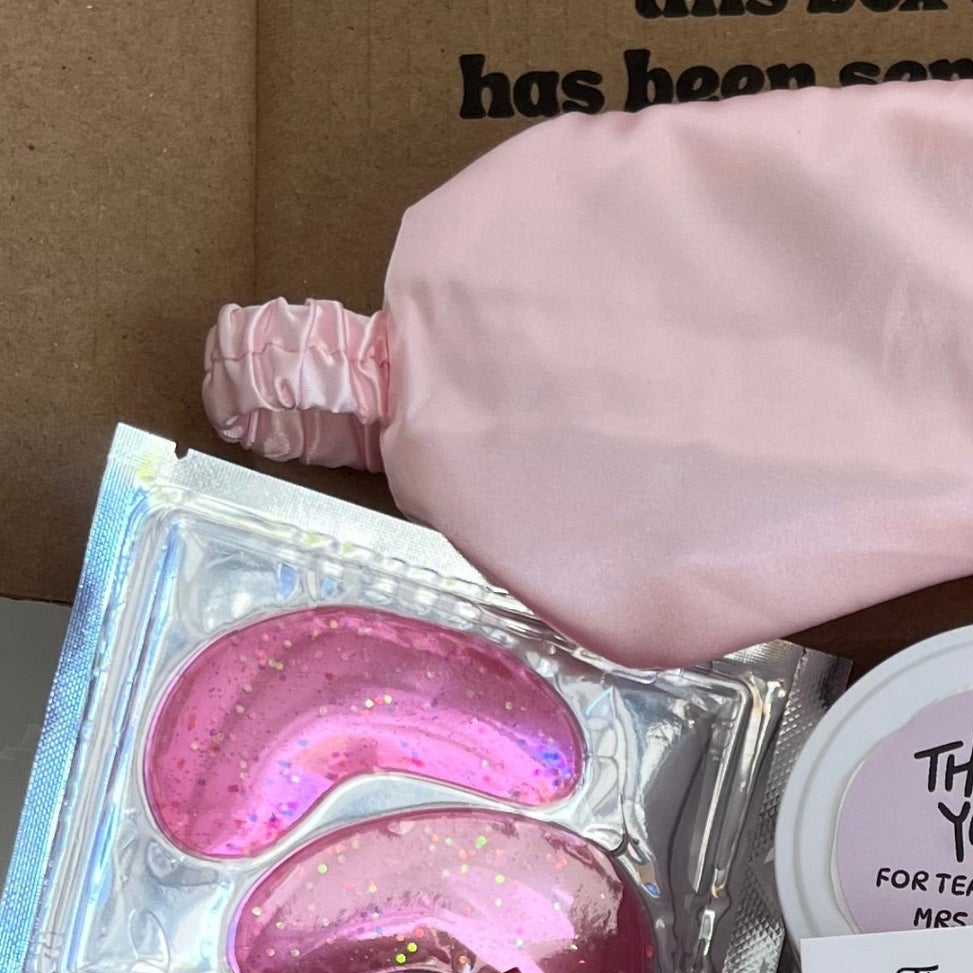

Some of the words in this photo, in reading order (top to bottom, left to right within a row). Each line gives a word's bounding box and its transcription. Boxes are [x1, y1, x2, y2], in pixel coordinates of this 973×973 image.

[459, 53, 605, 119] has
[875, 867, 929, 892] FOR
[912, 907, 969, 929] MRS
